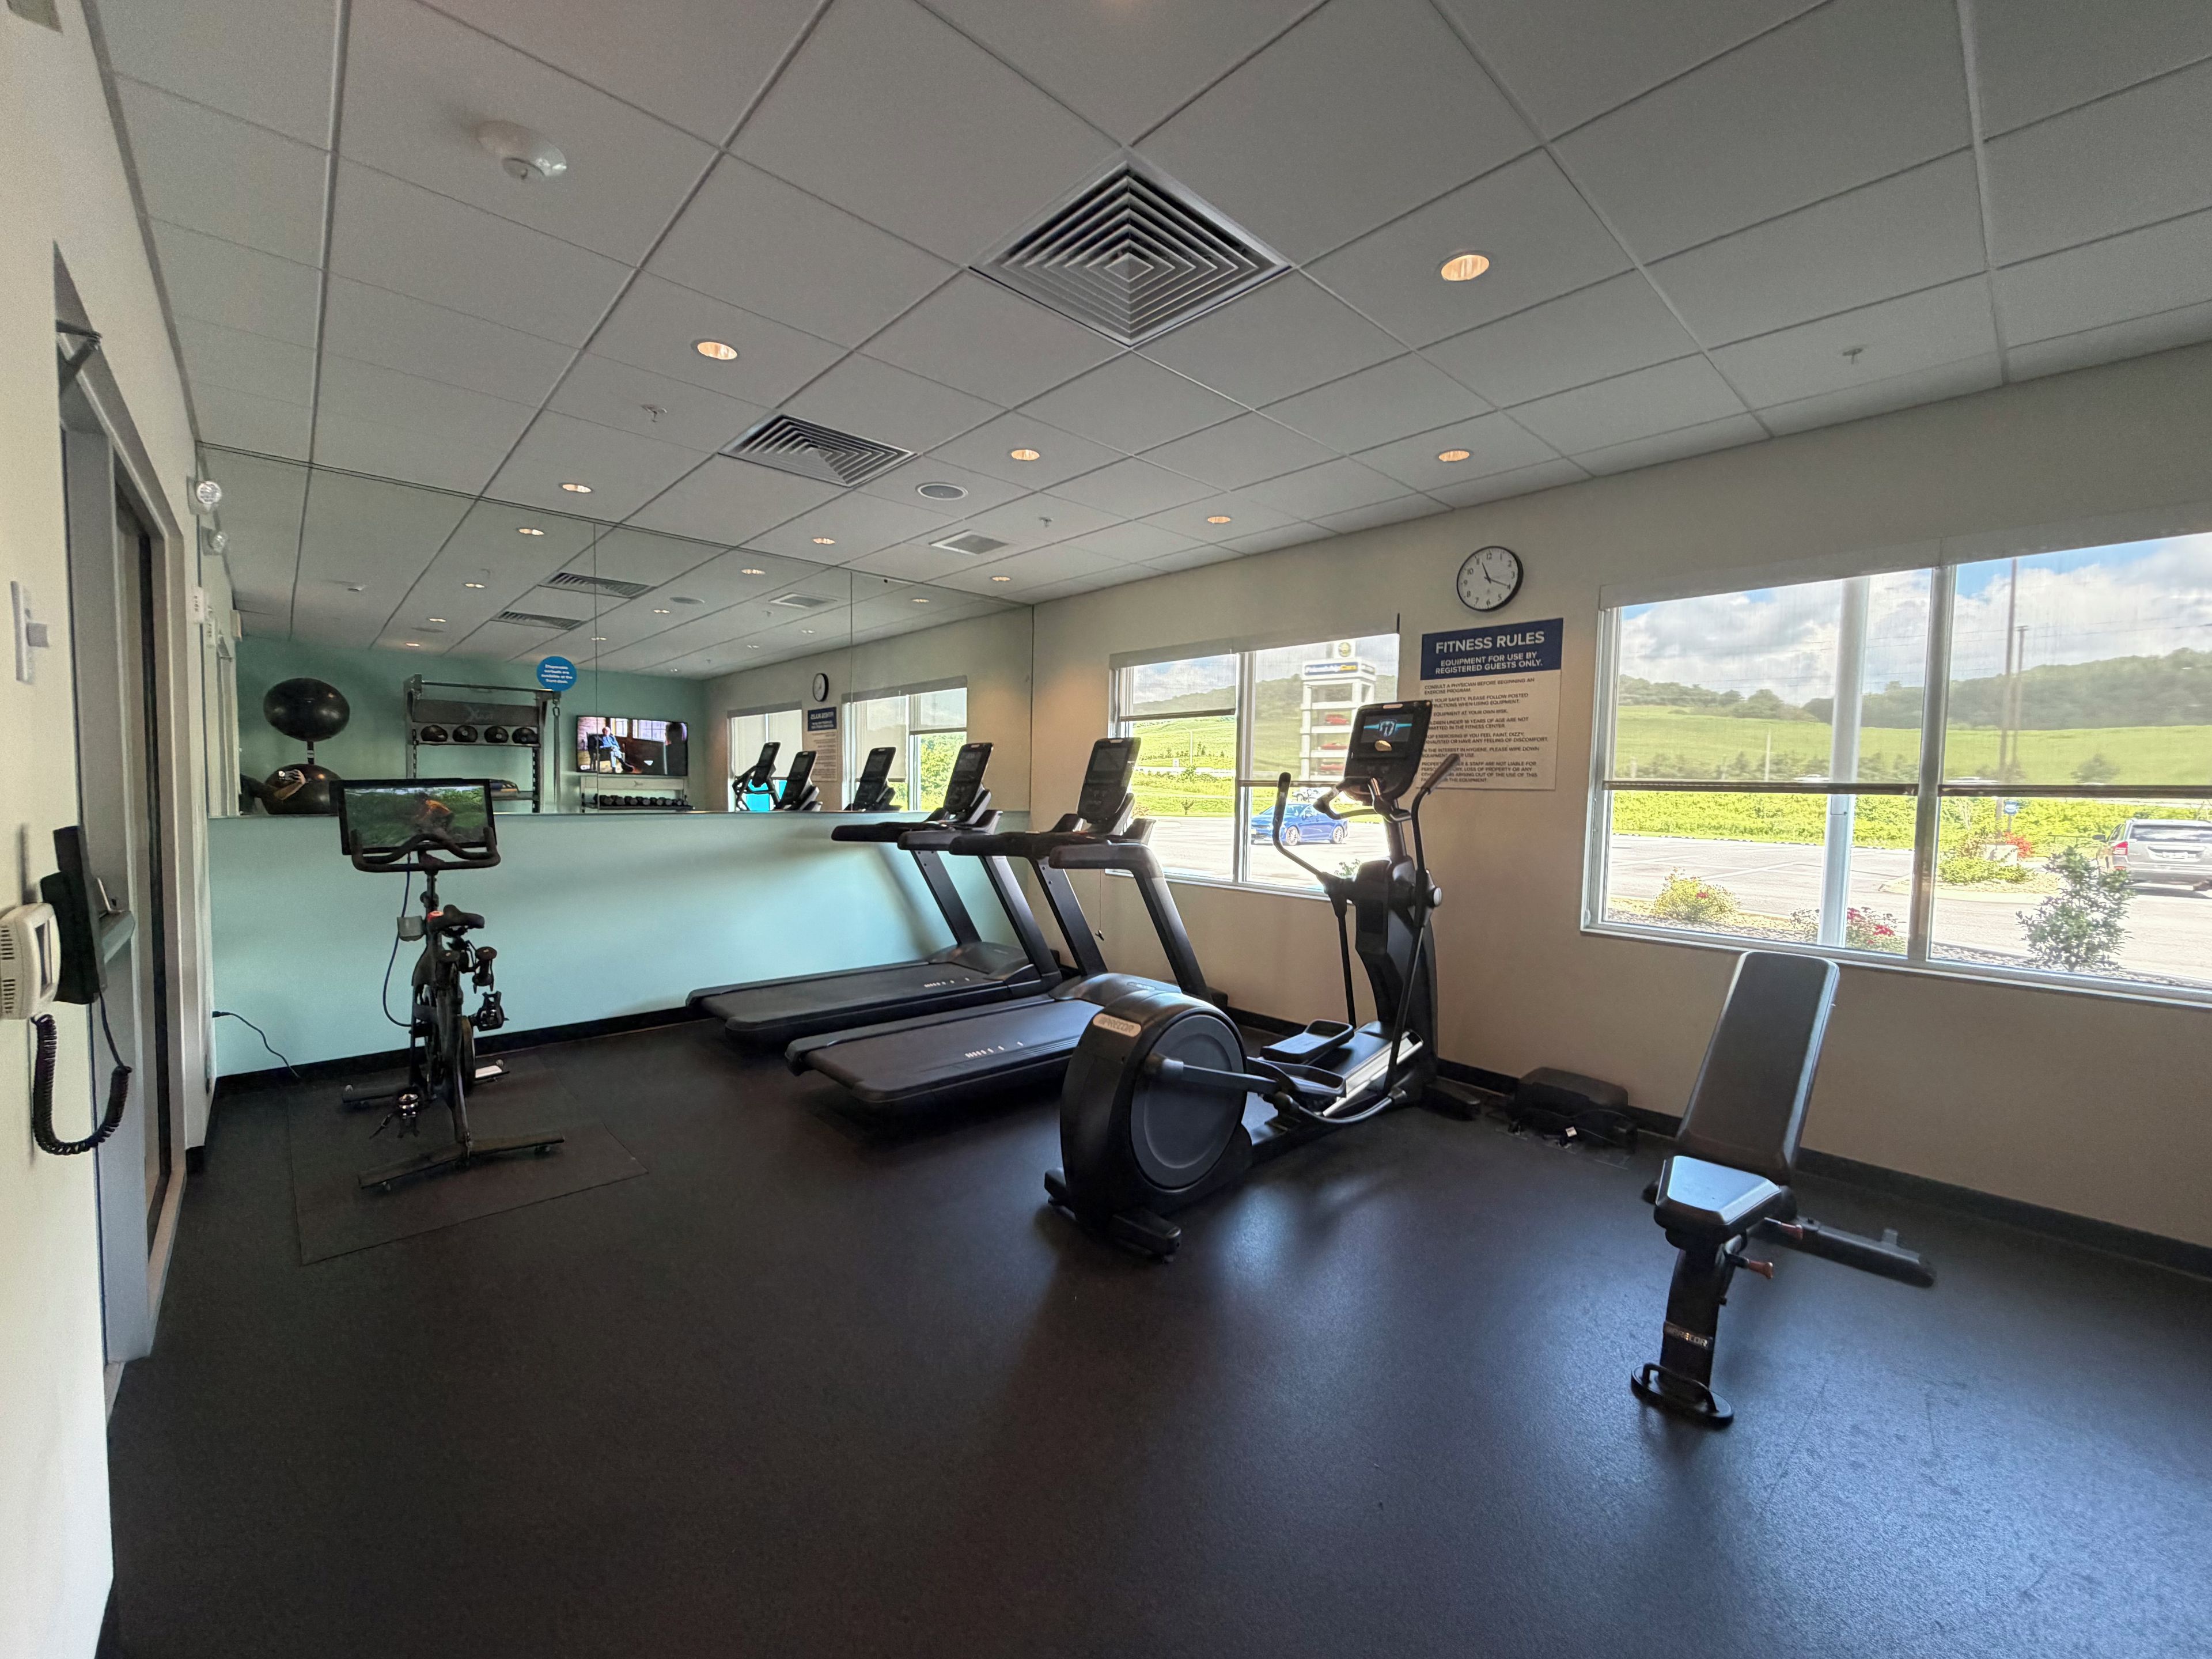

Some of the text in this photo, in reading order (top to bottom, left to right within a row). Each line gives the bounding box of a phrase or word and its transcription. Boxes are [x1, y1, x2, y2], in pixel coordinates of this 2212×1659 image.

[1435, 631, 1545, 654] FITNESS RULES
[1441, 651, 1537, 666] EQUIPMENT FOR USE BY
[1435, 659, 1543, 674] REGISTERED GUESTS ONLY.
